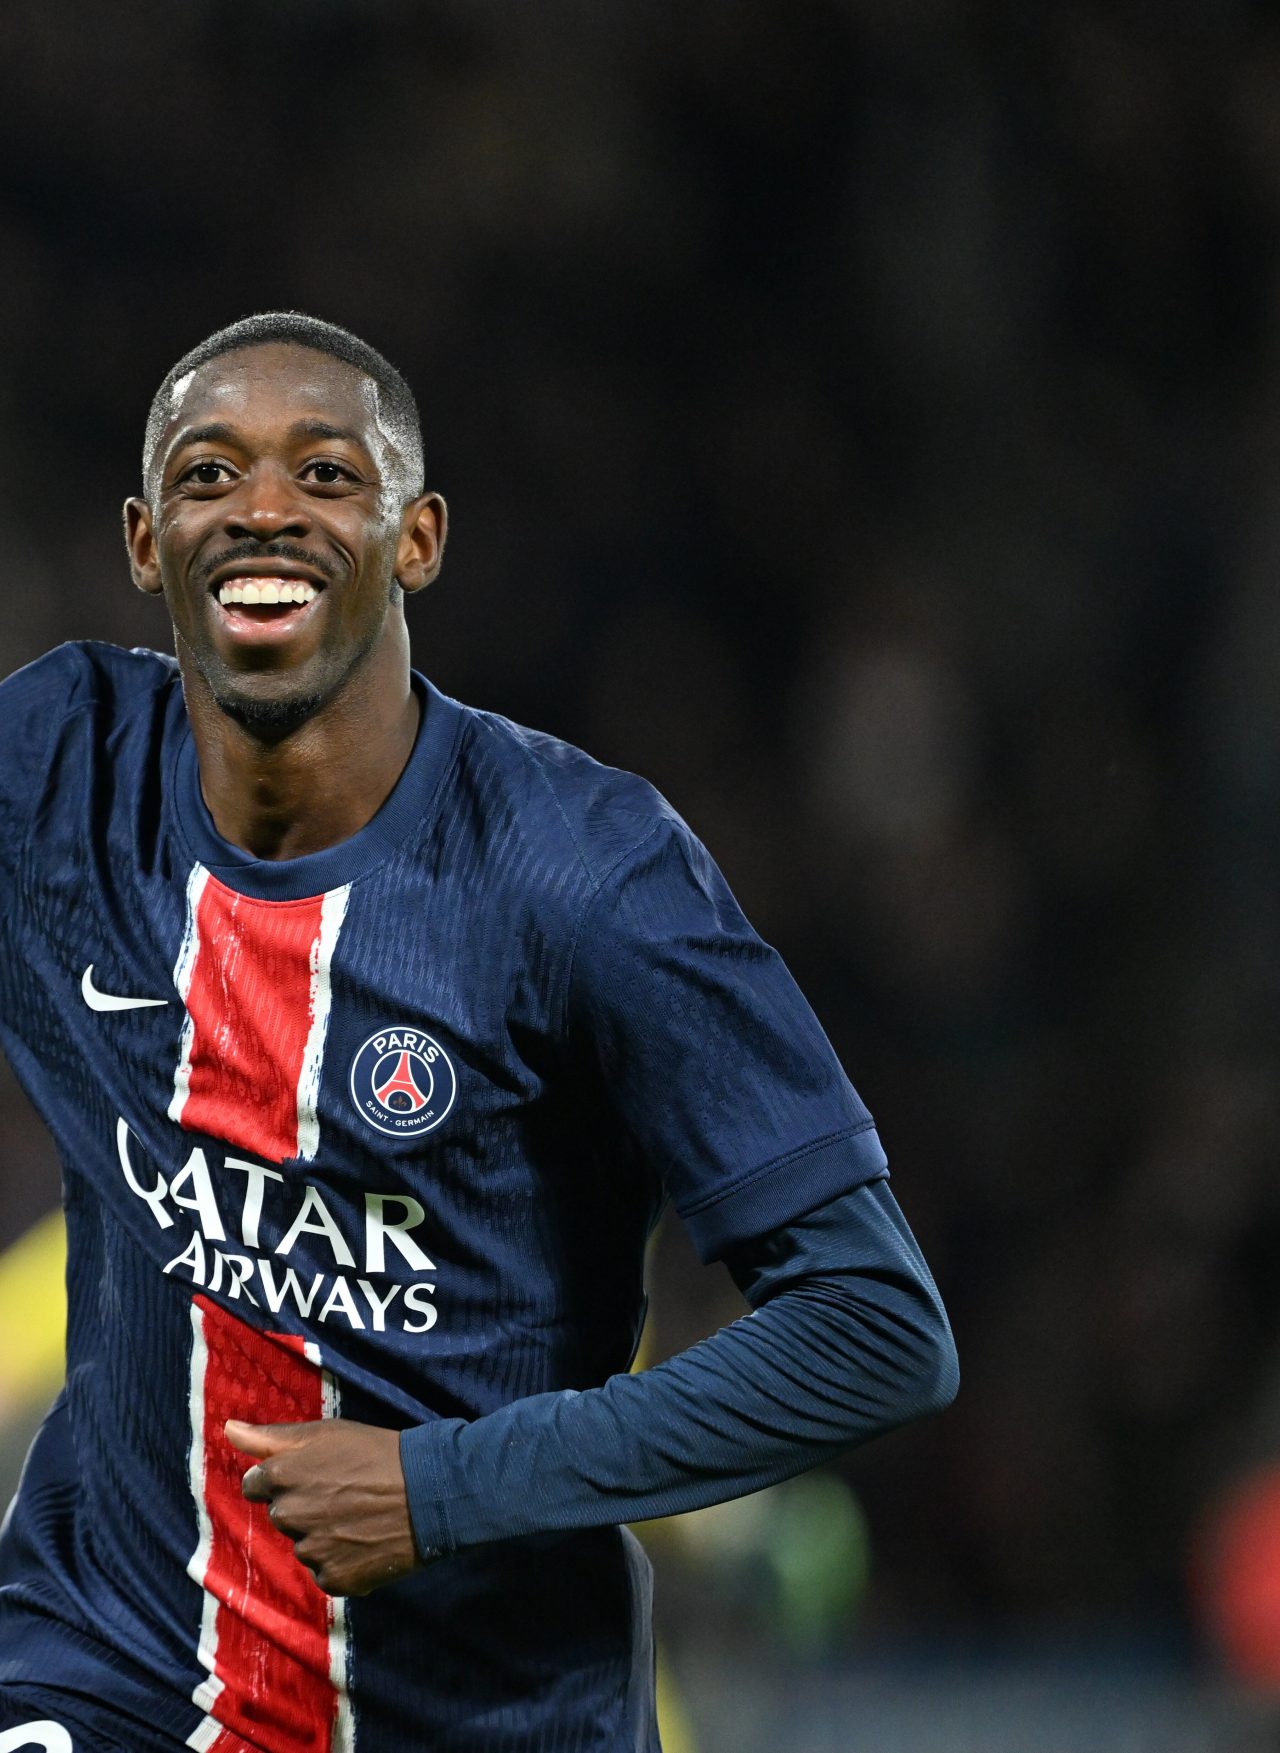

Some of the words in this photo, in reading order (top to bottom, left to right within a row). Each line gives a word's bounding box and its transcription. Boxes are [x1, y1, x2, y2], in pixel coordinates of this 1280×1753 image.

[373, 1033, 439, 1063] PARIS
[395, 1111, 434, 1127] GERMAIN
[116, 1116, 437, 1274] QATAR
[162, 1230, 439, 1333] AIRWAYS
